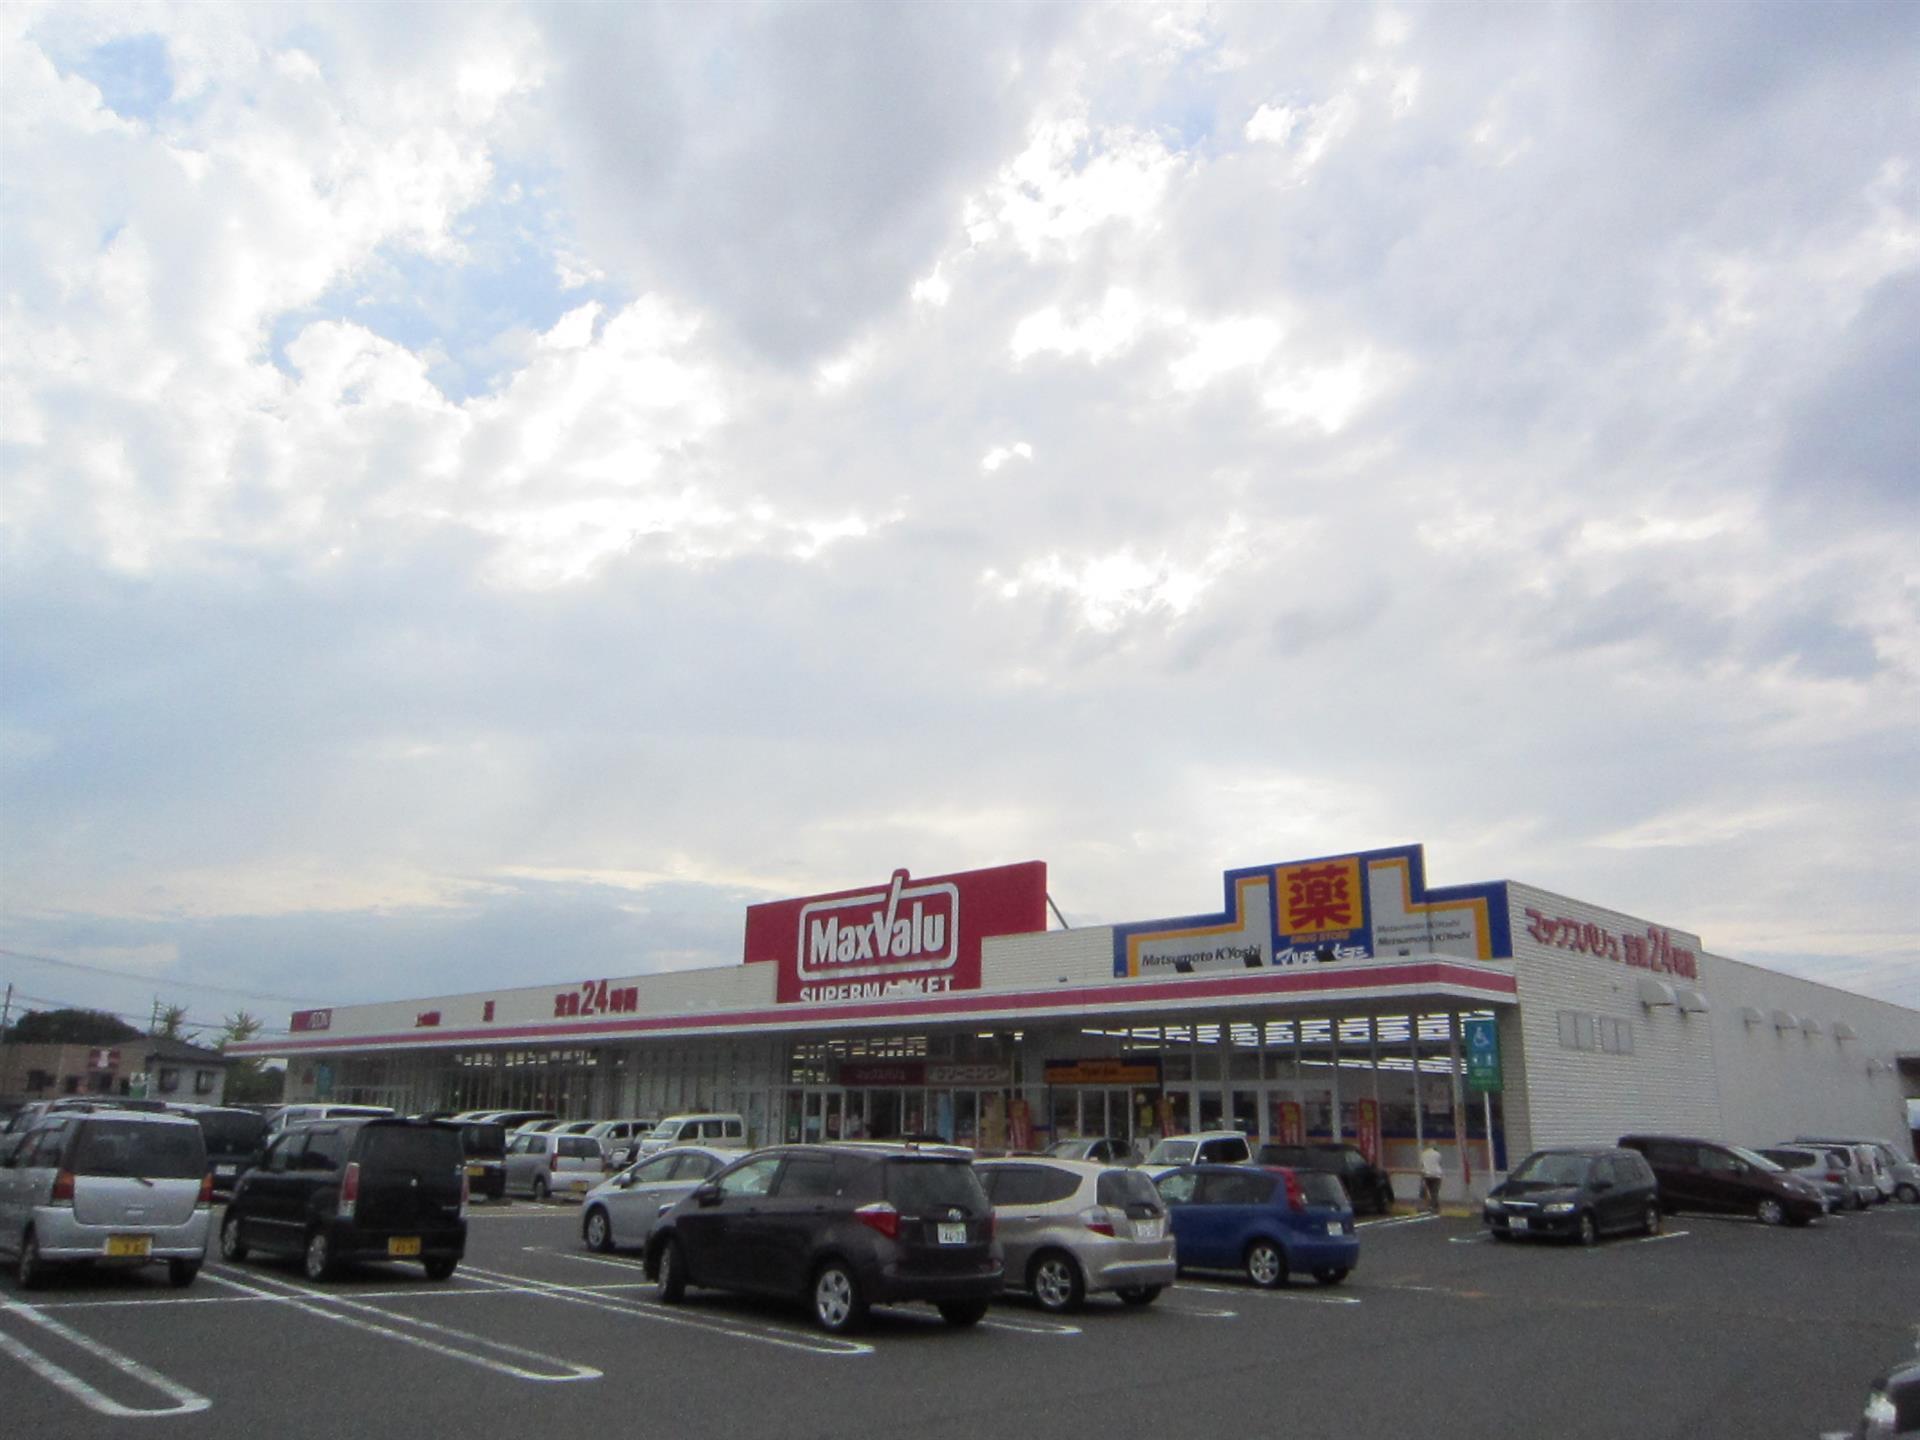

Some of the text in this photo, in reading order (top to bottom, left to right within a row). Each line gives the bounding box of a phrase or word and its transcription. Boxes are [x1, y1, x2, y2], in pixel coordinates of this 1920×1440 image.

[810, 876, 945, 964] MaxValu
[1287, 864, 1352, 929] 薬
[800, 975, 954, 1001] SUPERMAKET
